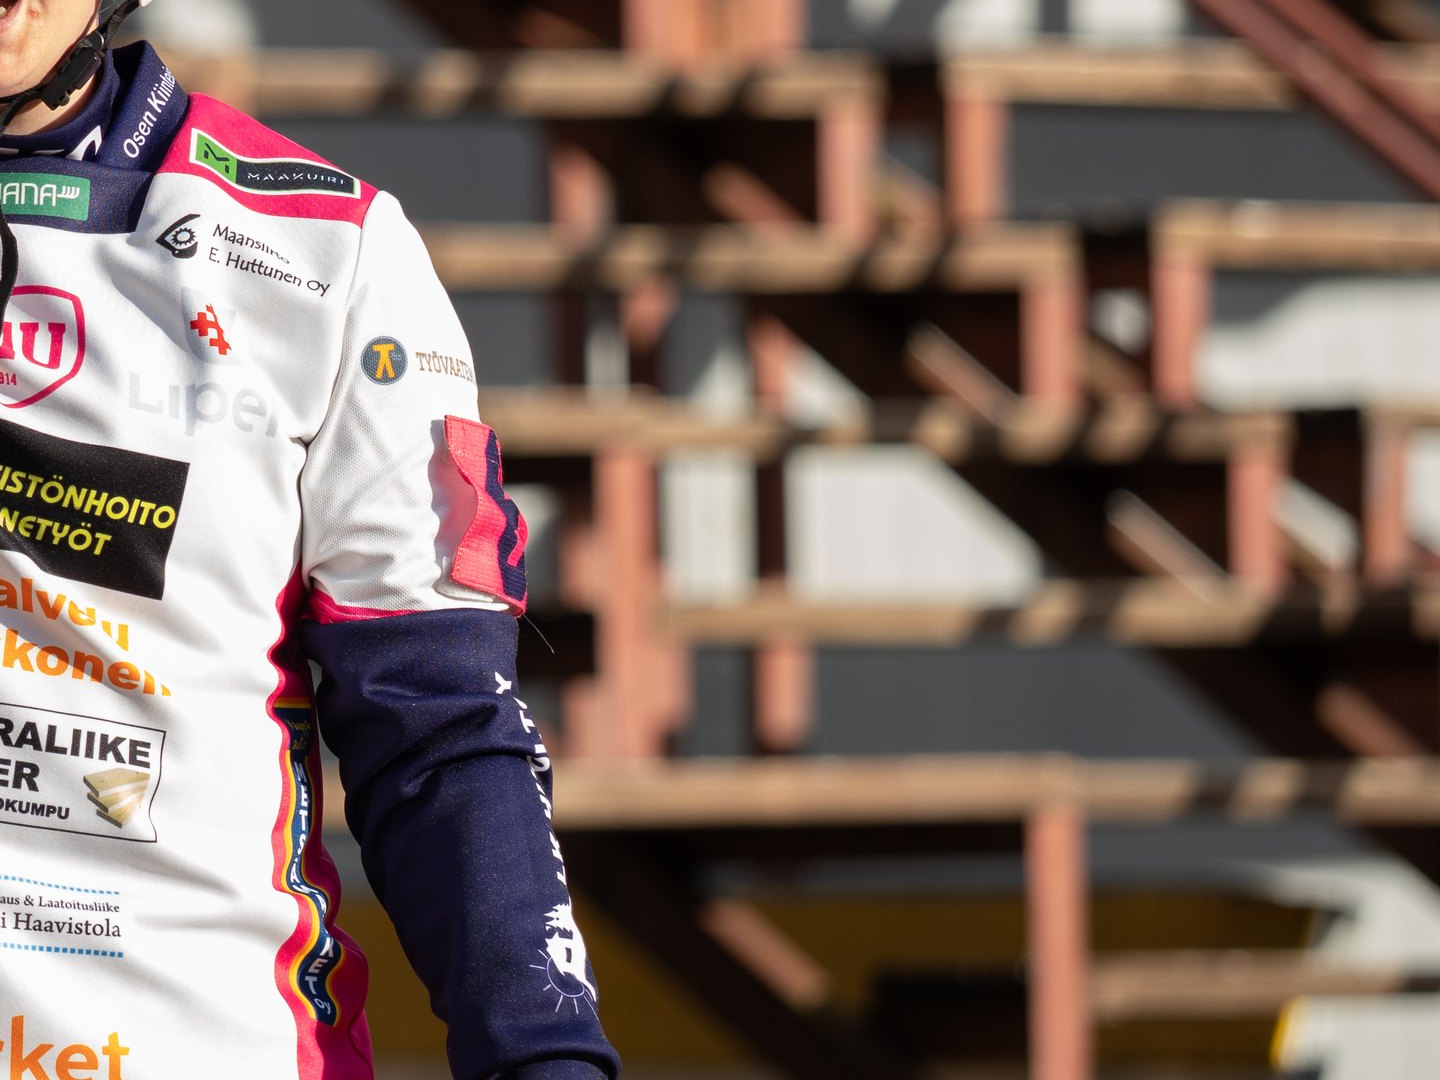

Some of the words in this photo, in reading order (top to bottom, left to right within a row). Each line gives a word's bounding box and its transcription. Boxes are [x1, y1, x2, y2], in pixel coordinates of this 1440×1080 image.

[123, 110, 157, 158] Osen
[209, 246, 220, 264] E.
[225, 251, 302, 287] Huttunen
[306, 280, 331, 297] Oy
[23, 894, 35, 907] &
[38, 895, 120, 913] Laatoitusliike
[12, 911, 122, 938] Haavistola
